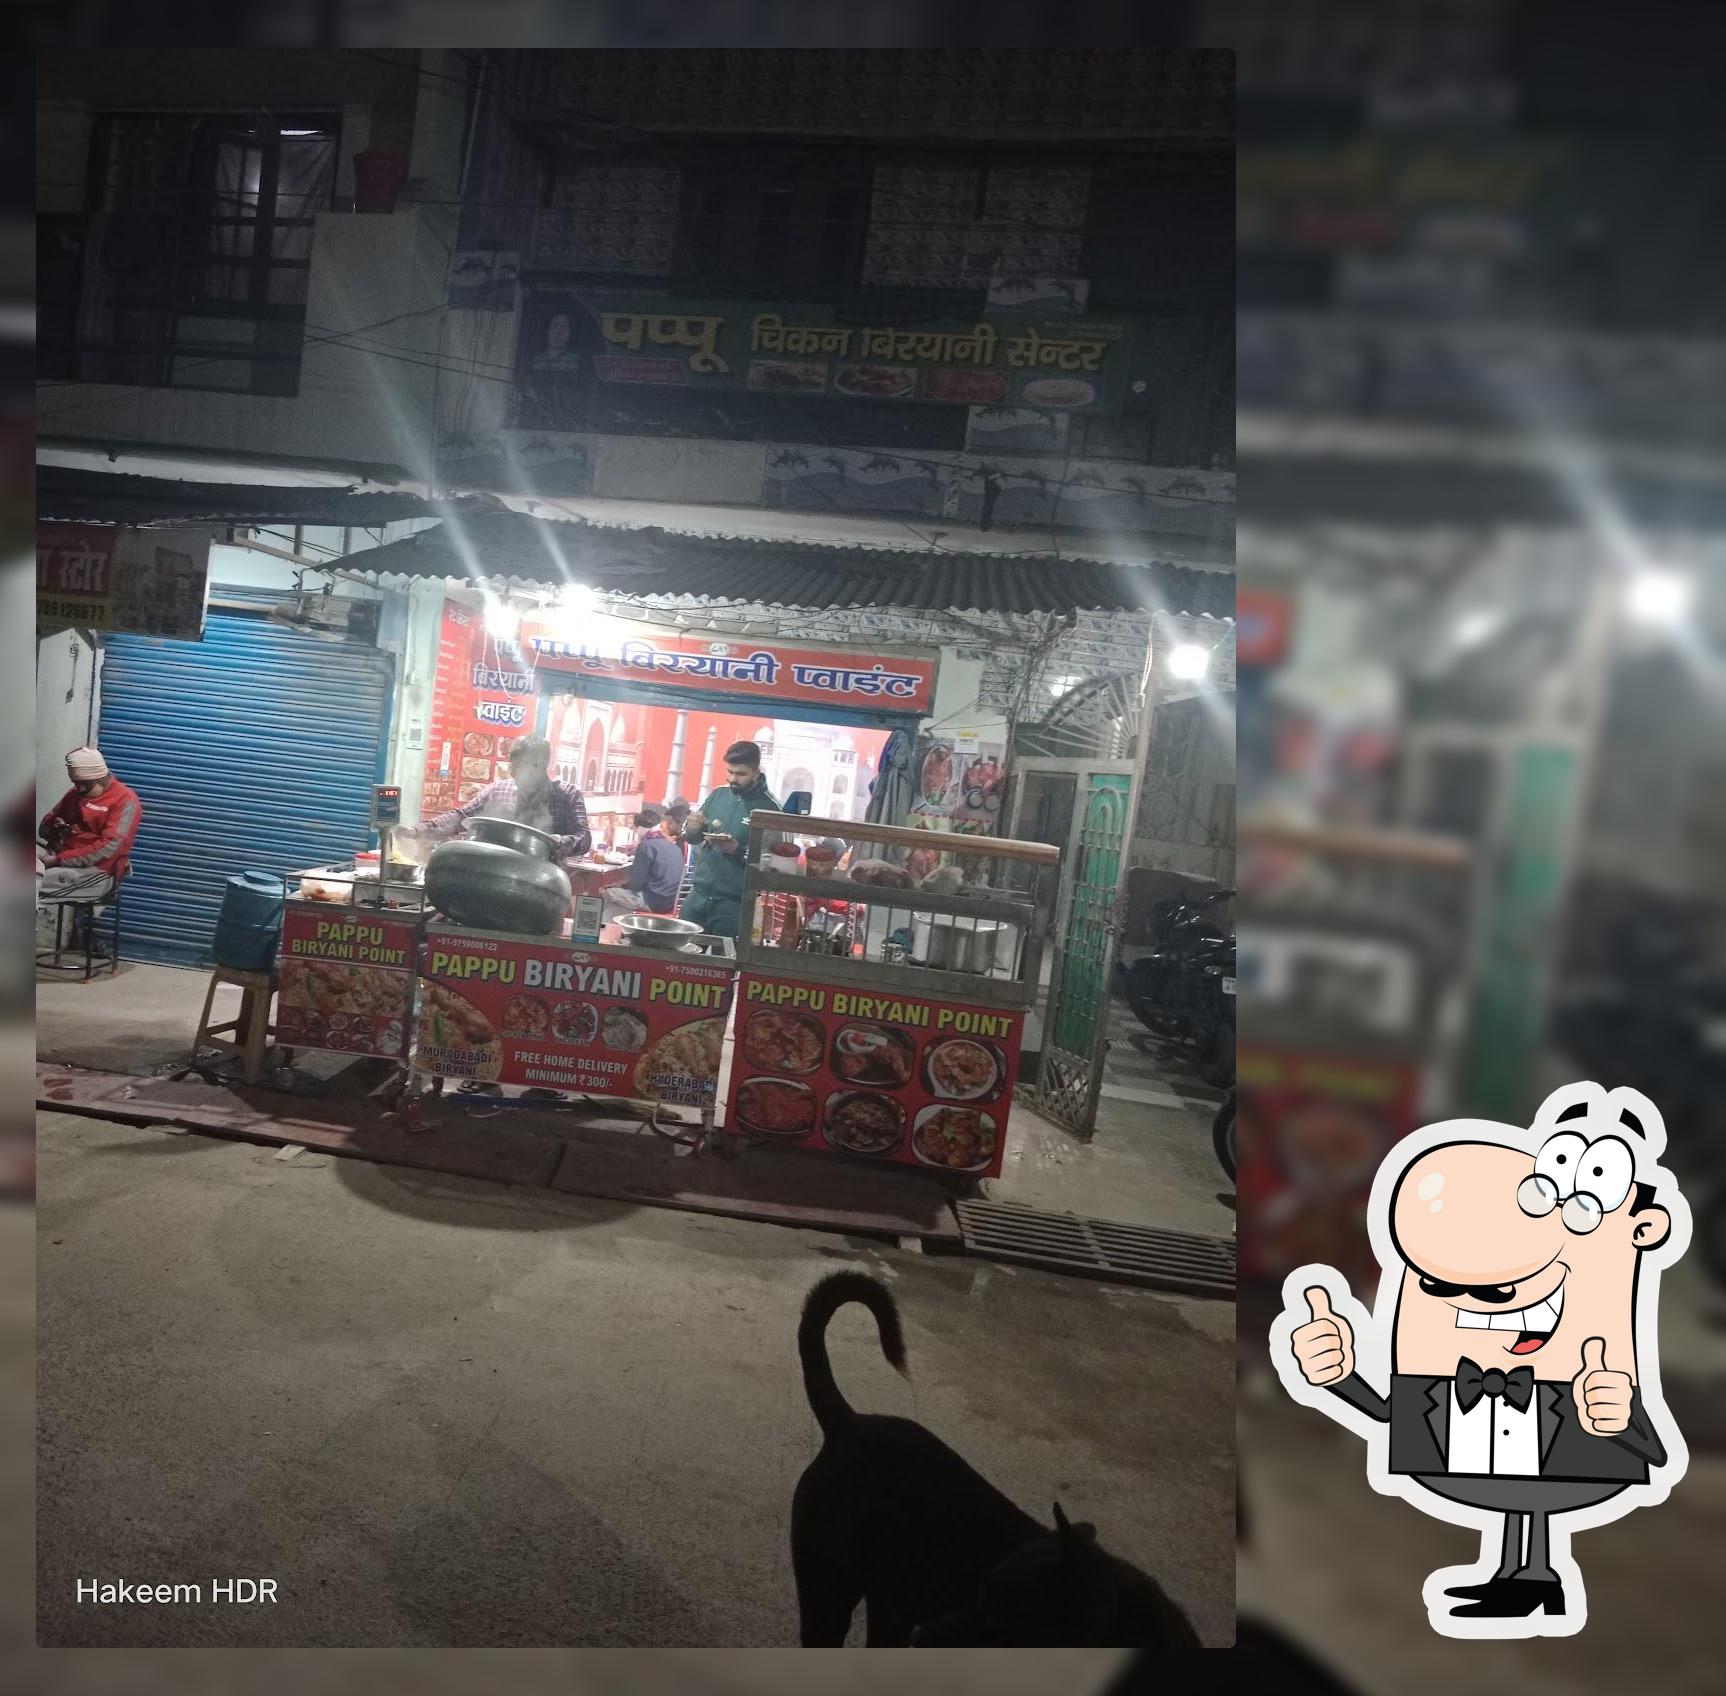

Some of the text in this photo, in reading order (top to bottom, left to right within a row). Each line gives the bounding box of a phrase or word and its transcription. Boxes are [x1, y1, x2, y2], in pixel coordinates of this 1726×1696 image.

[600, 312, 730, 373] पप्पू
[751, 313, 851, 357] चिकन
[1007, 327, 1106, 371] सेन्टर
[791, 664, 924, 697] प्वाइंट
[317, 921, 384, 946] PAPPU
[291, 938, 407, 965] BIRYANI POINT
[431, 951, 727, 1010] PAPPU BIRYANI POINT
[746, 980, 1014, 1039] PAPPU BIRYANI POINT
[434, 1062, 477, 1076] BIRYANI
[513, 1050, 629, 1075] FREE HOME DELIVERY
[525, 1068, 577, 1085] MINIMUM
